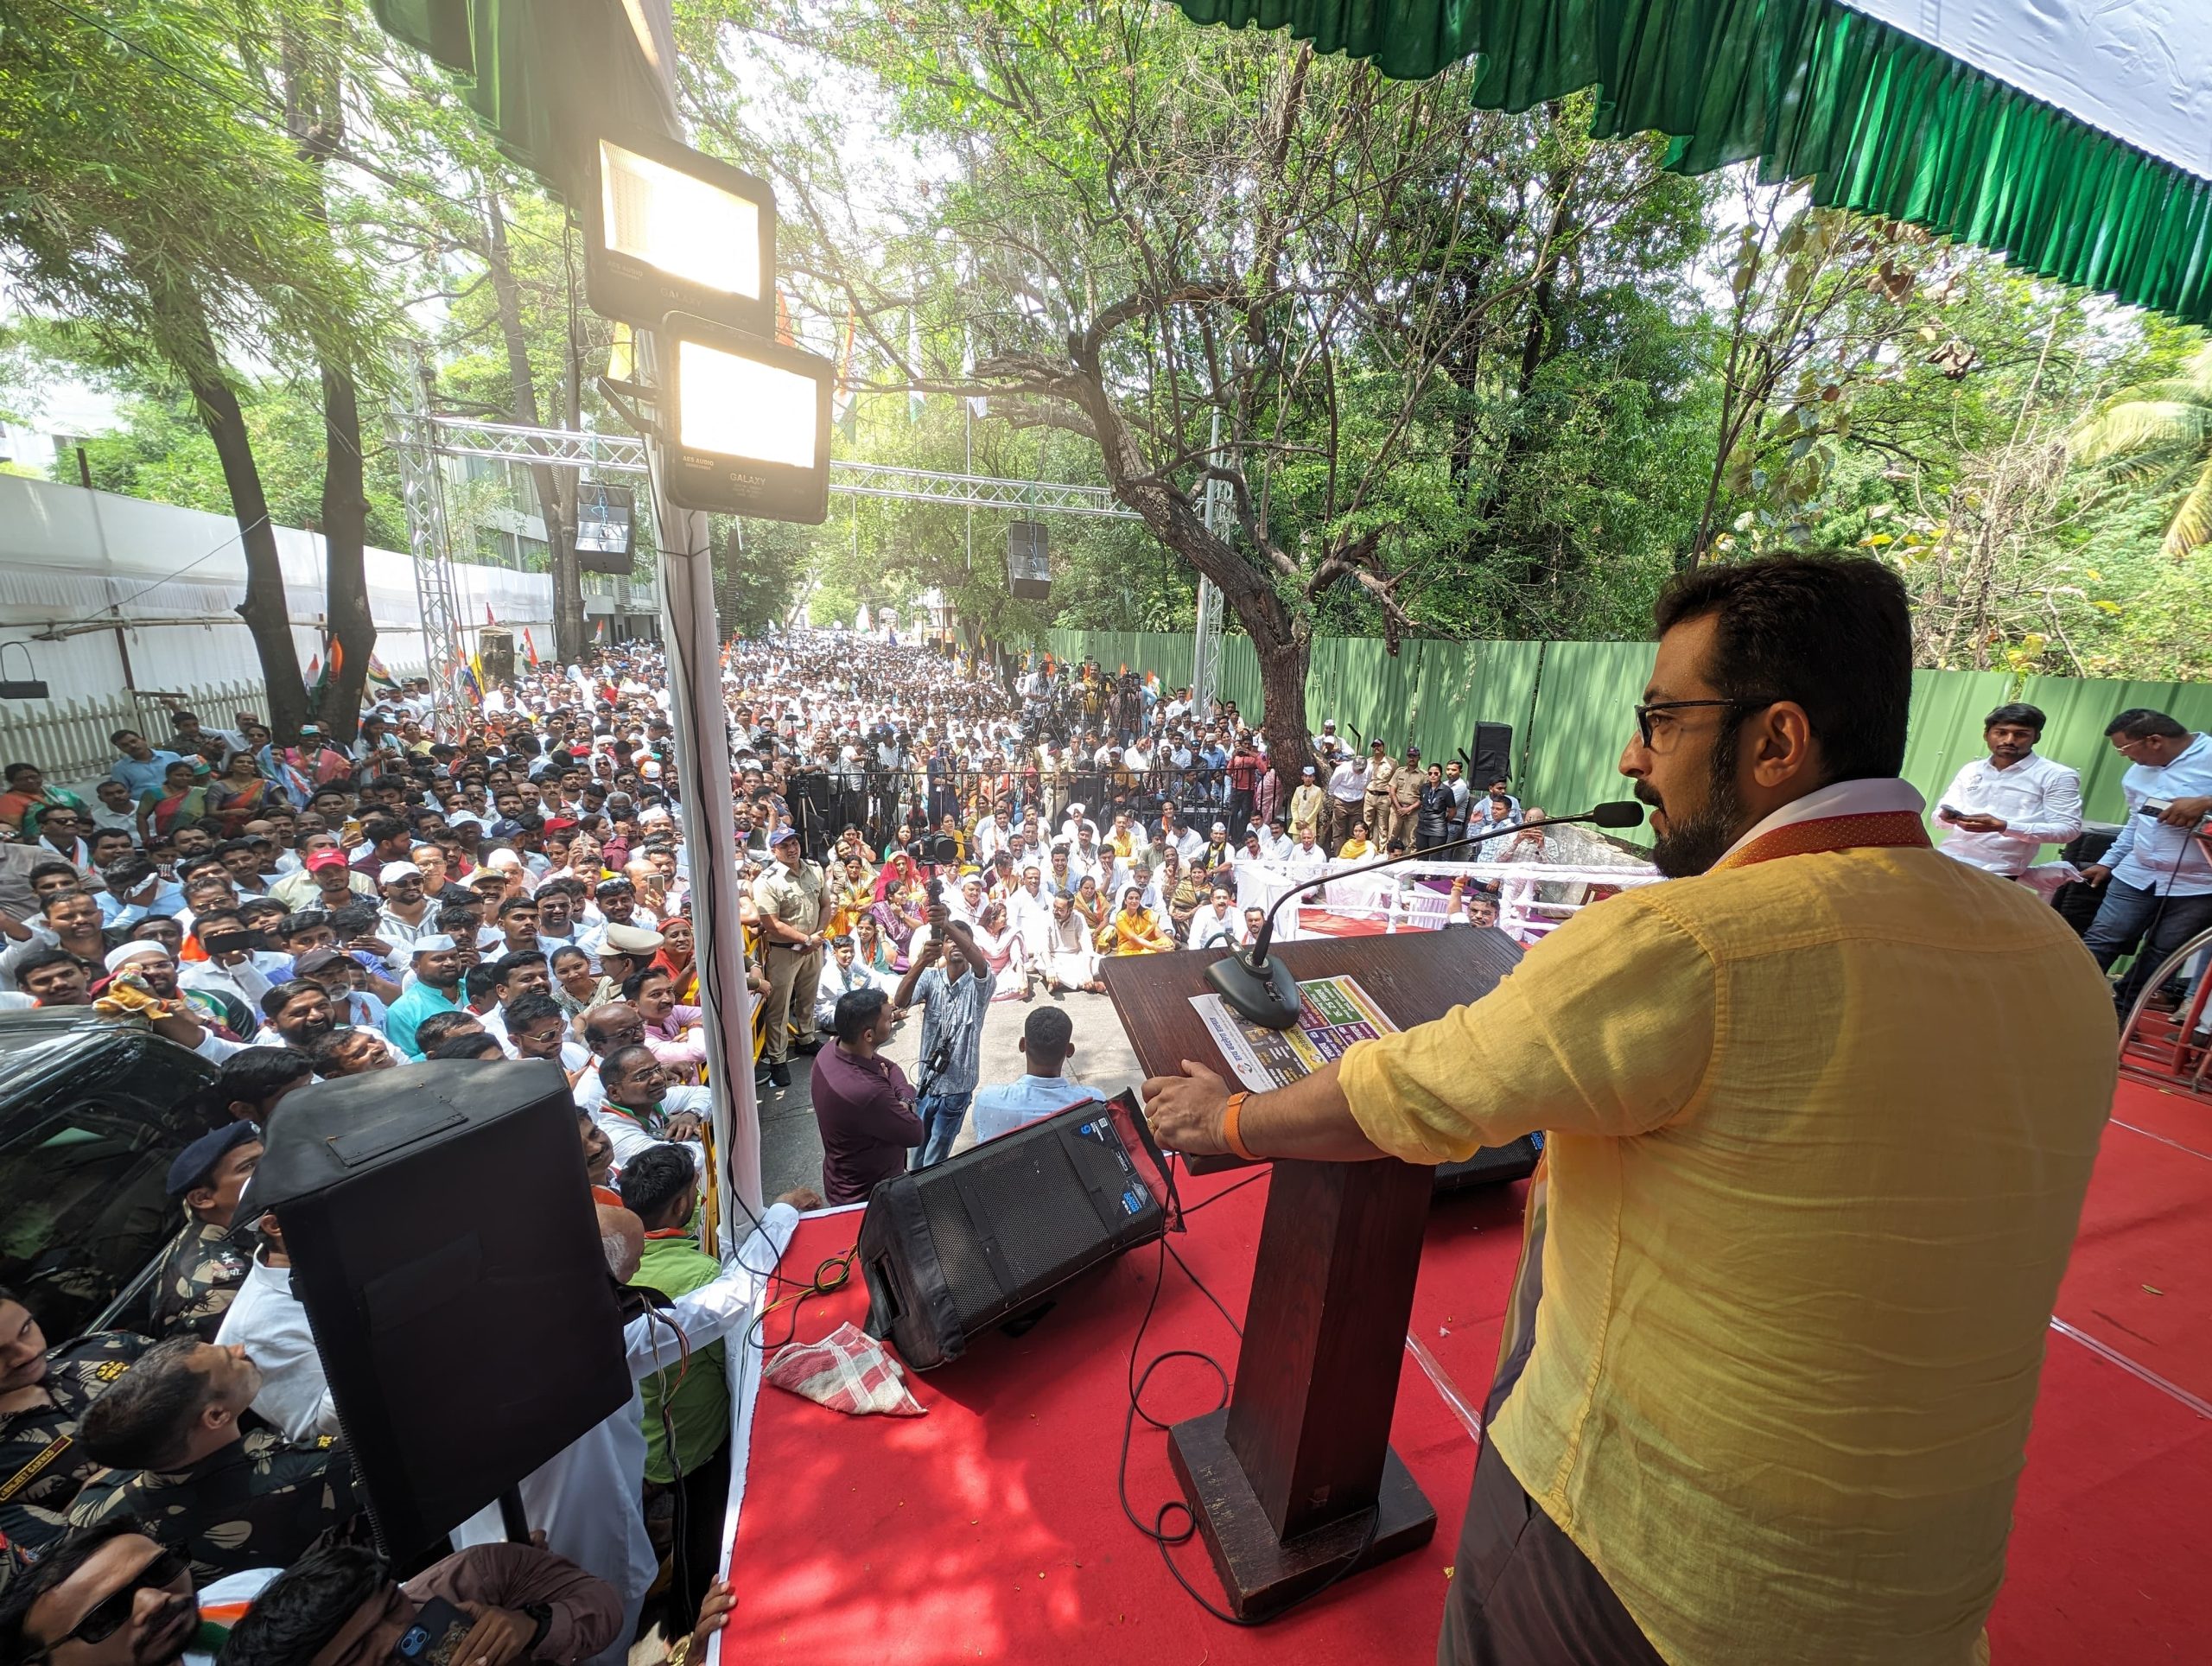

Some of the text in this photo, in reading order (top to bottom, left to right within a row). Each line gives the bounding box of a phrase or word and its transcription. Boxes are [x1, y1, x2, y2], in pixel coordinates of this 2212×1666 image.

[660, 287, 702, 307] GALAXY
[729, 473, 766, 486] GALAXY
[1313, 989, 1330, 1002] लाख
[1209, 1017, 1243, 1061] हाथ बदलेगा हालात
[1349, 1025, 1365, 1040] लाख
[1318, 1042, 1335, 1058] लाख
[1080, 1124, 1091, 1135] 6
[1115, 1151, 1128, 1172] QSC
[1123, 1192, 1136, 1211] 2000
[1, 1450, 54, 1497] ABHIJEET GAIKWAD
